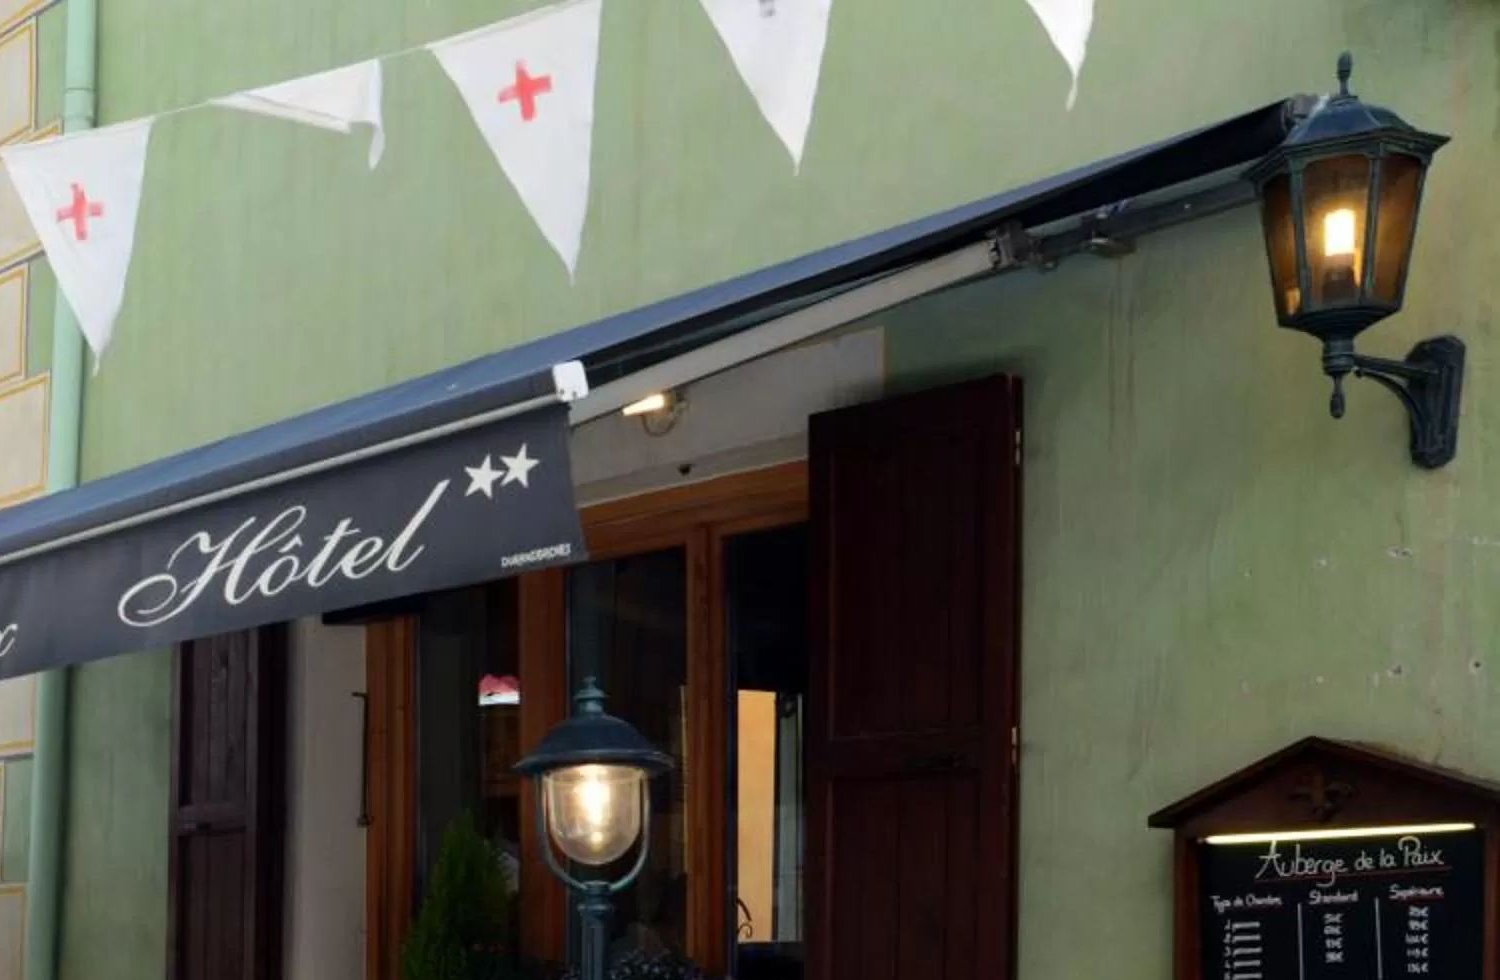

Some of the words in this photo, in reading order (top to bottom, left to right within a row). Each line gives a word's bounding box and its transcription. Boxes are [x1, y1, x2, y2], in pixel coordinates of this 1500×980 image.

[117, 478, 452, 627] Hôtel
[1255, 840, 1349, 888] Auberge
[1354, 850, 1375, 871] de
[1379, 847, 1397, 868] la
[1398, 835, 1445, 867] Paix
